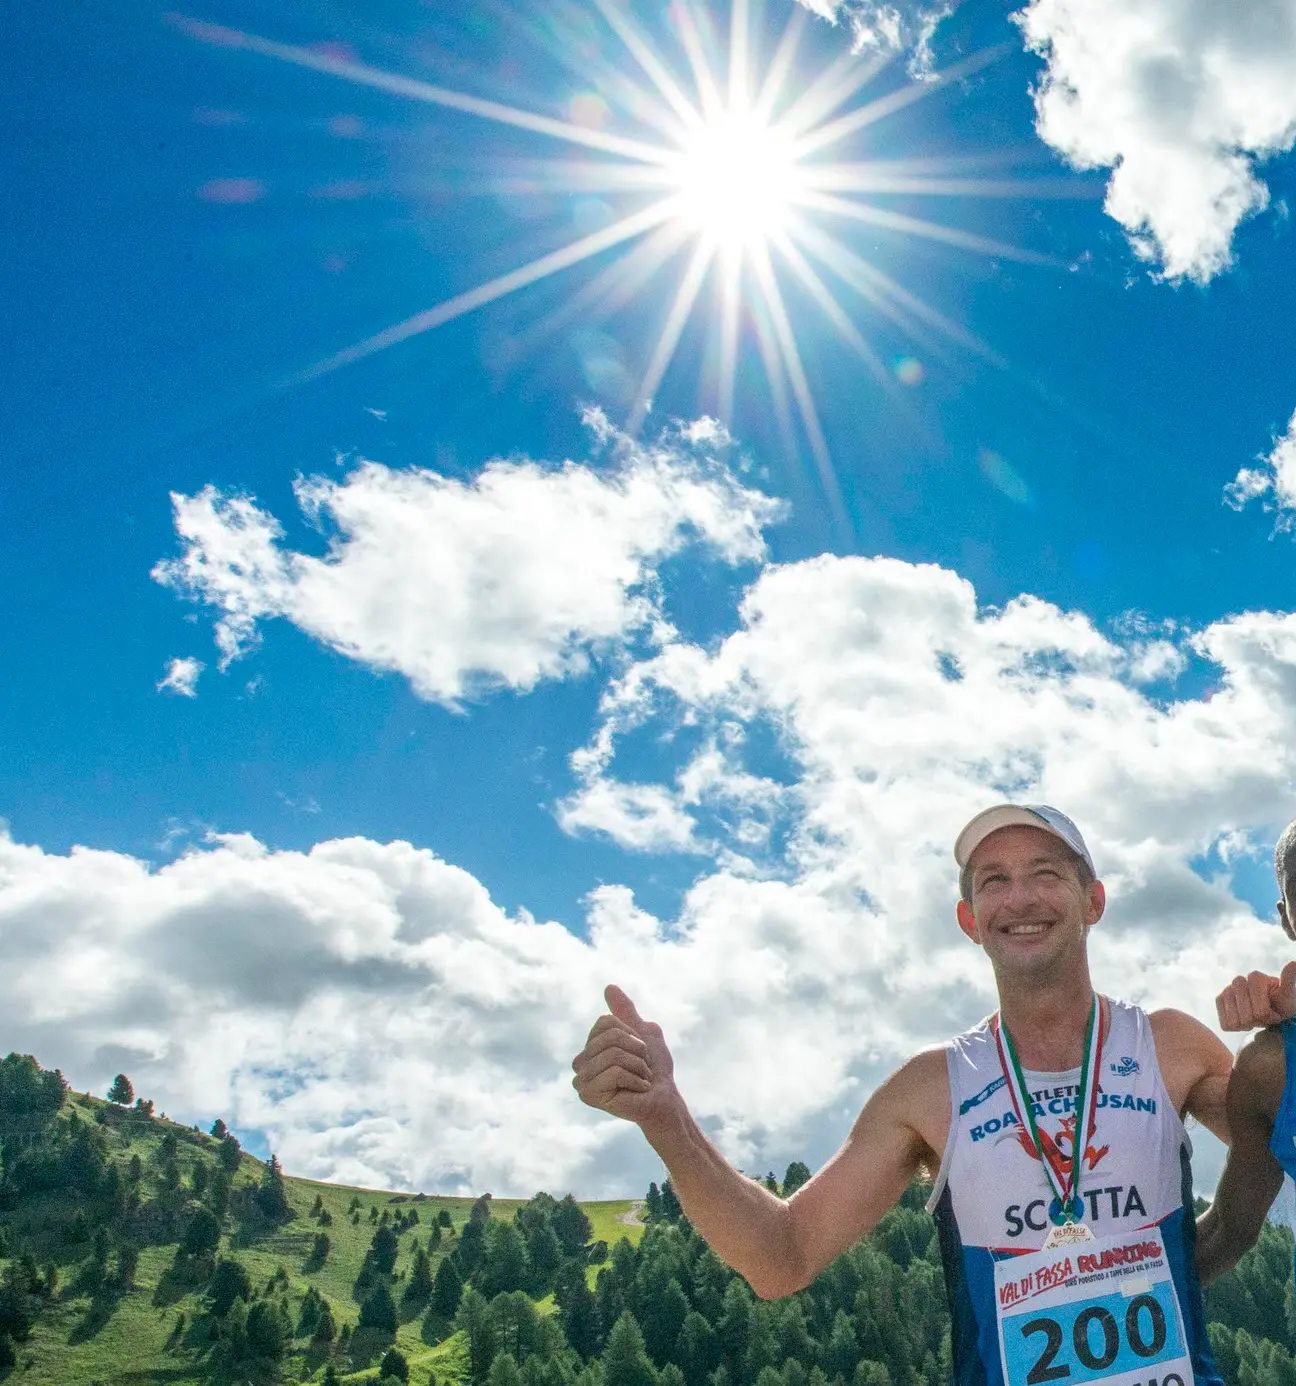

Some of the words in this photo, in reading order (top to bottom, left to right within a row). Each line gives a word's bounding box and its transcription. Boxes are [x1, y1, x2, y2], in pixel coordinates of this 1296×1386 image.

[969, 1103, 1046, 1142] ROAA
[1049, 1093, 1157, 1115] CHUSANI
[1028, 1083, 1103, 1103] ATLETIA
[999, 1280, 1020, 1304] VAL
[1034, 1257, 1073, 1290] FASSA
[1077, 1240, 1163, 1274] RUNNING
[1020, 1294, 1167, 1386] 200
